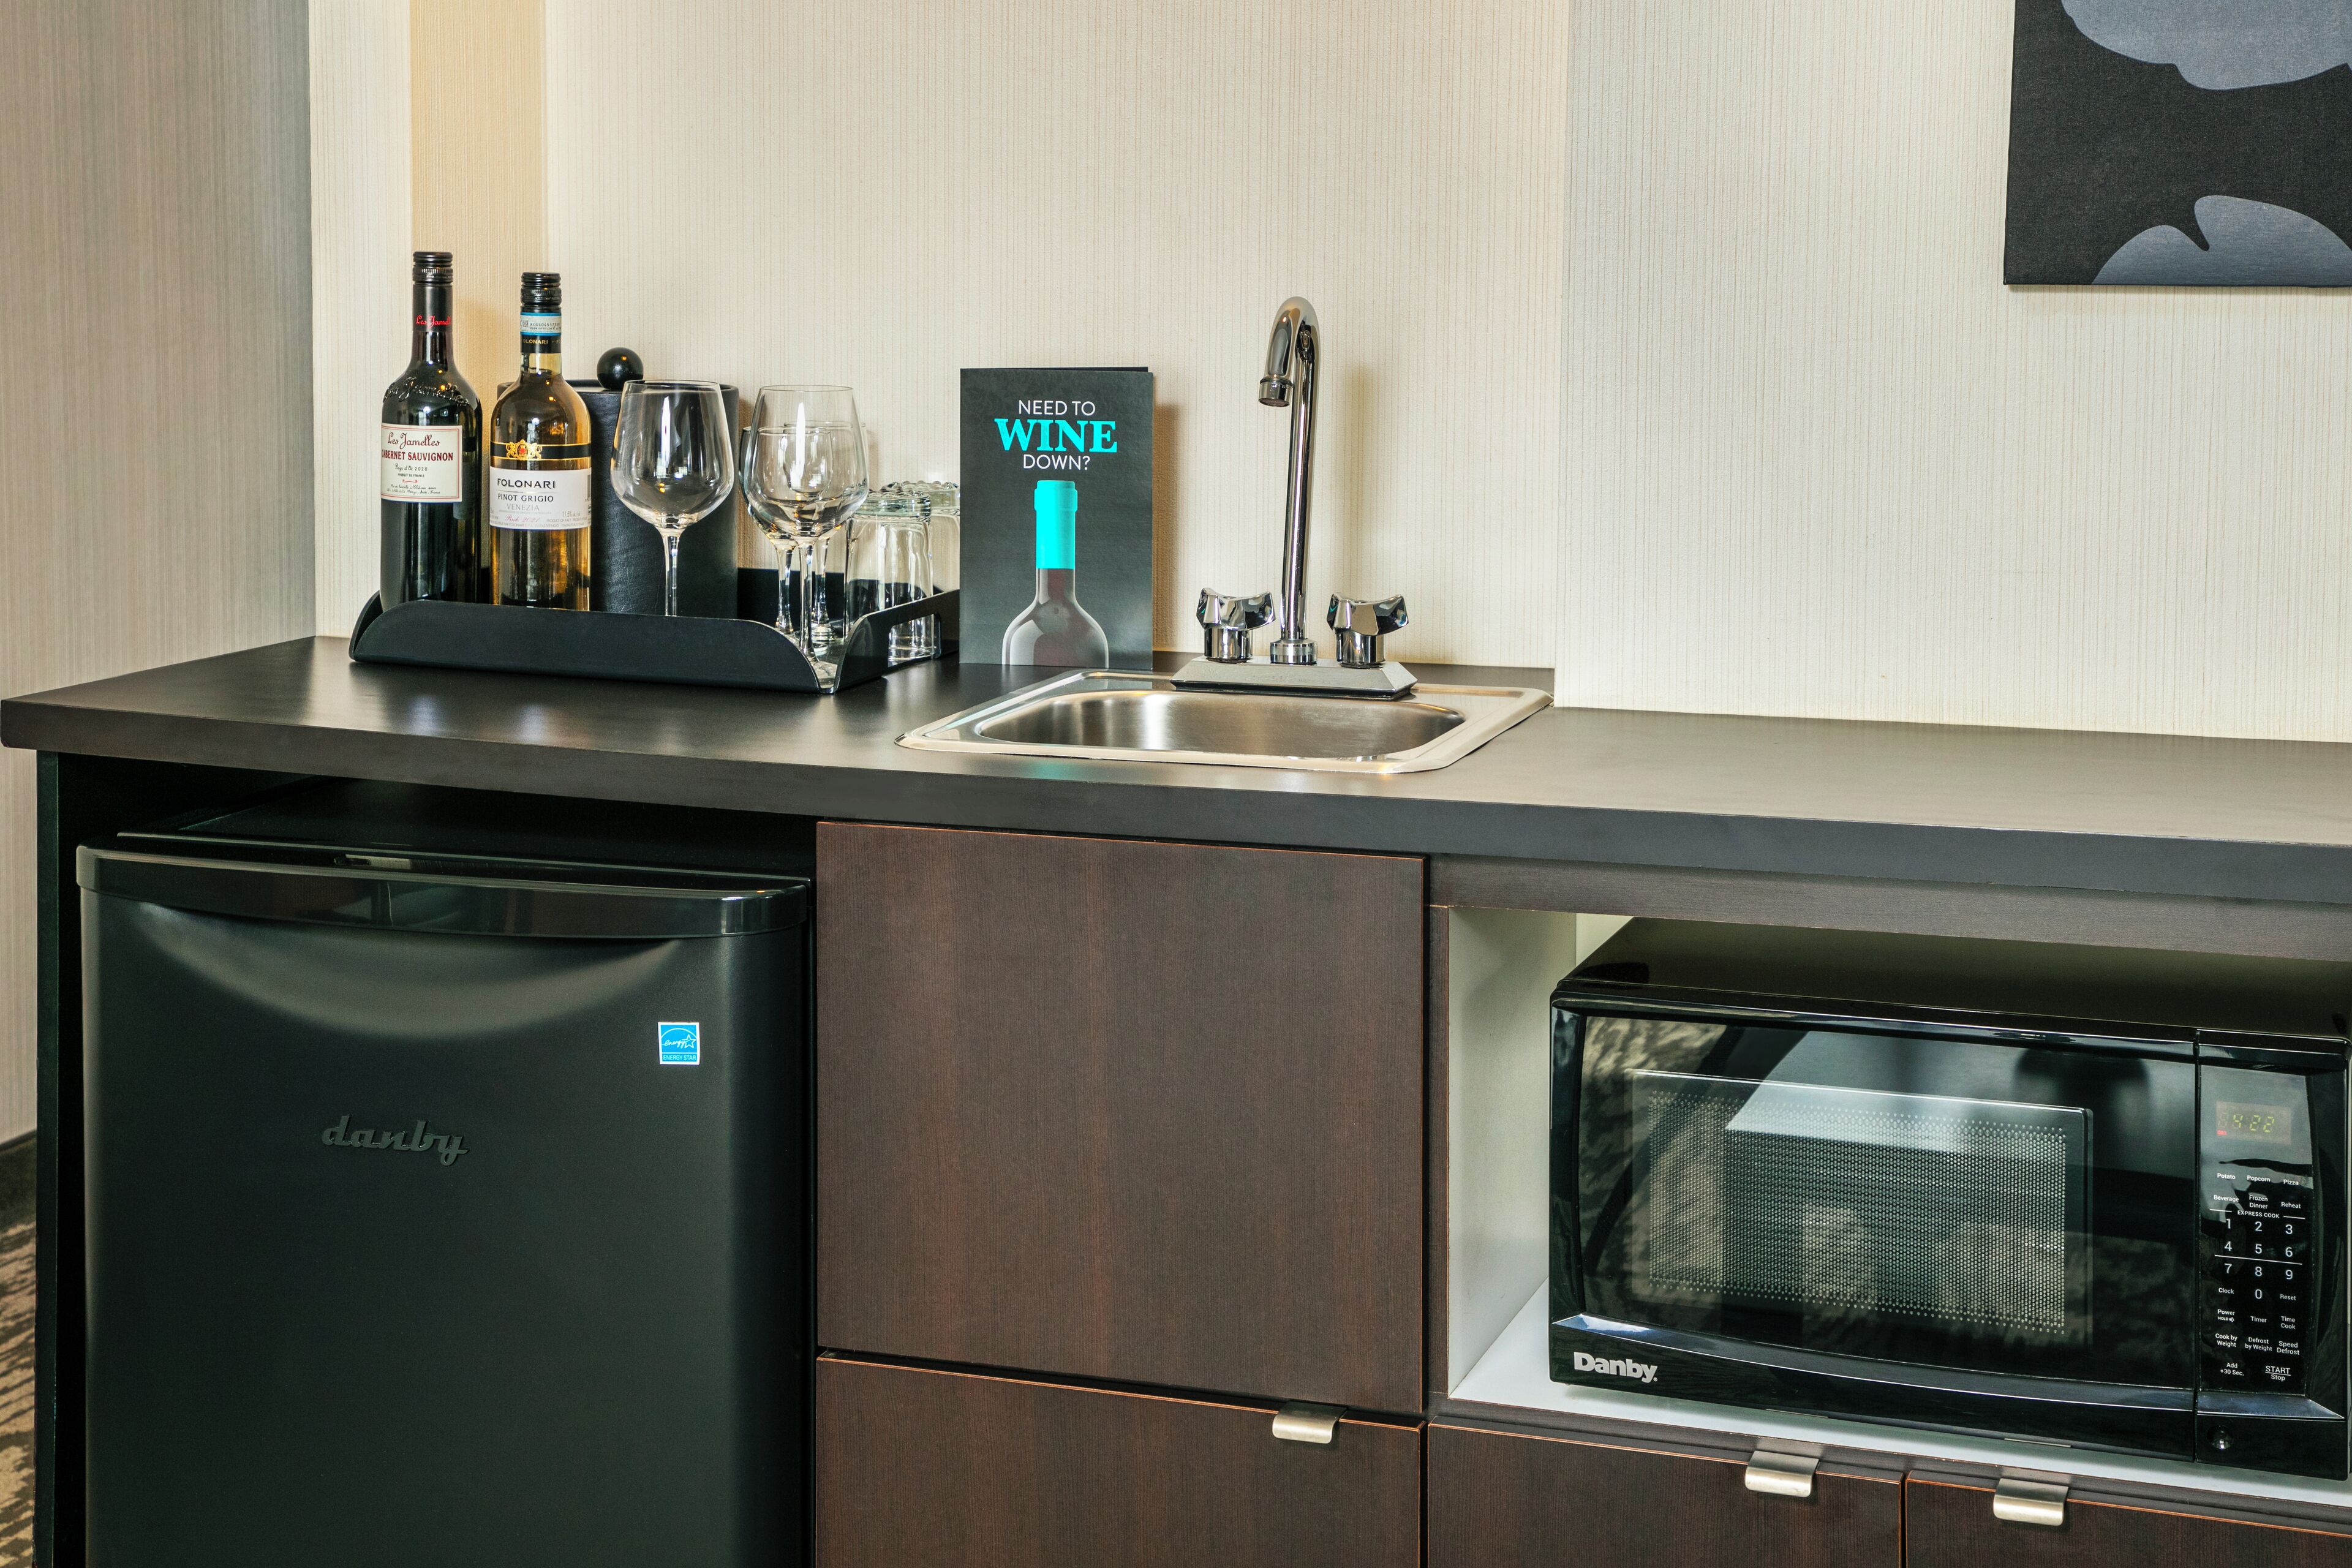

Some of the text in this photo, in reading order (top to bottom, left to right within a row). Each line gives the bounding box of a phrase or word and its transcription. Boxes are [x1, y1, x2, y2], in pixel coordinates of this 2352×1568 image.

[416, 315, 427, 325] Les
[1019, 399, 1096, 416] NEED TO
[388, 432, 440, 449] Les Jamelles
[994, 418, 1118, 453] WINE
[382, 449, 453, 461] CABERNET SAUVIGNON
[1023, 454, 1091, 470] DOWN?
[497, 478, 556, 489] FOLONARI
[662, 1039, 690, 1049] energy
[322, 1114, 470, 1166] danby
[2226, 1218, 2231, 1229] 1
[2255, 1221, 2263, 1232] 2
[2285, 1224, 2293, 1234] 3
[2224, 1241, 2233, 1251] 4
[2255, 1243, 2263, 1254] 5
[2285, 1247, 2293, 1257] 6
[2224, 1263, 2233, 1273] 7
[2255, 1266, 2263, 1276] 8
[2285, 1269, 2293, 1280] 9
[2255, 1289, 2263, 1299] 0
[2277, 1347, 2300, 1355] Defrost
[2266, 1365, 2291, 1374] START
